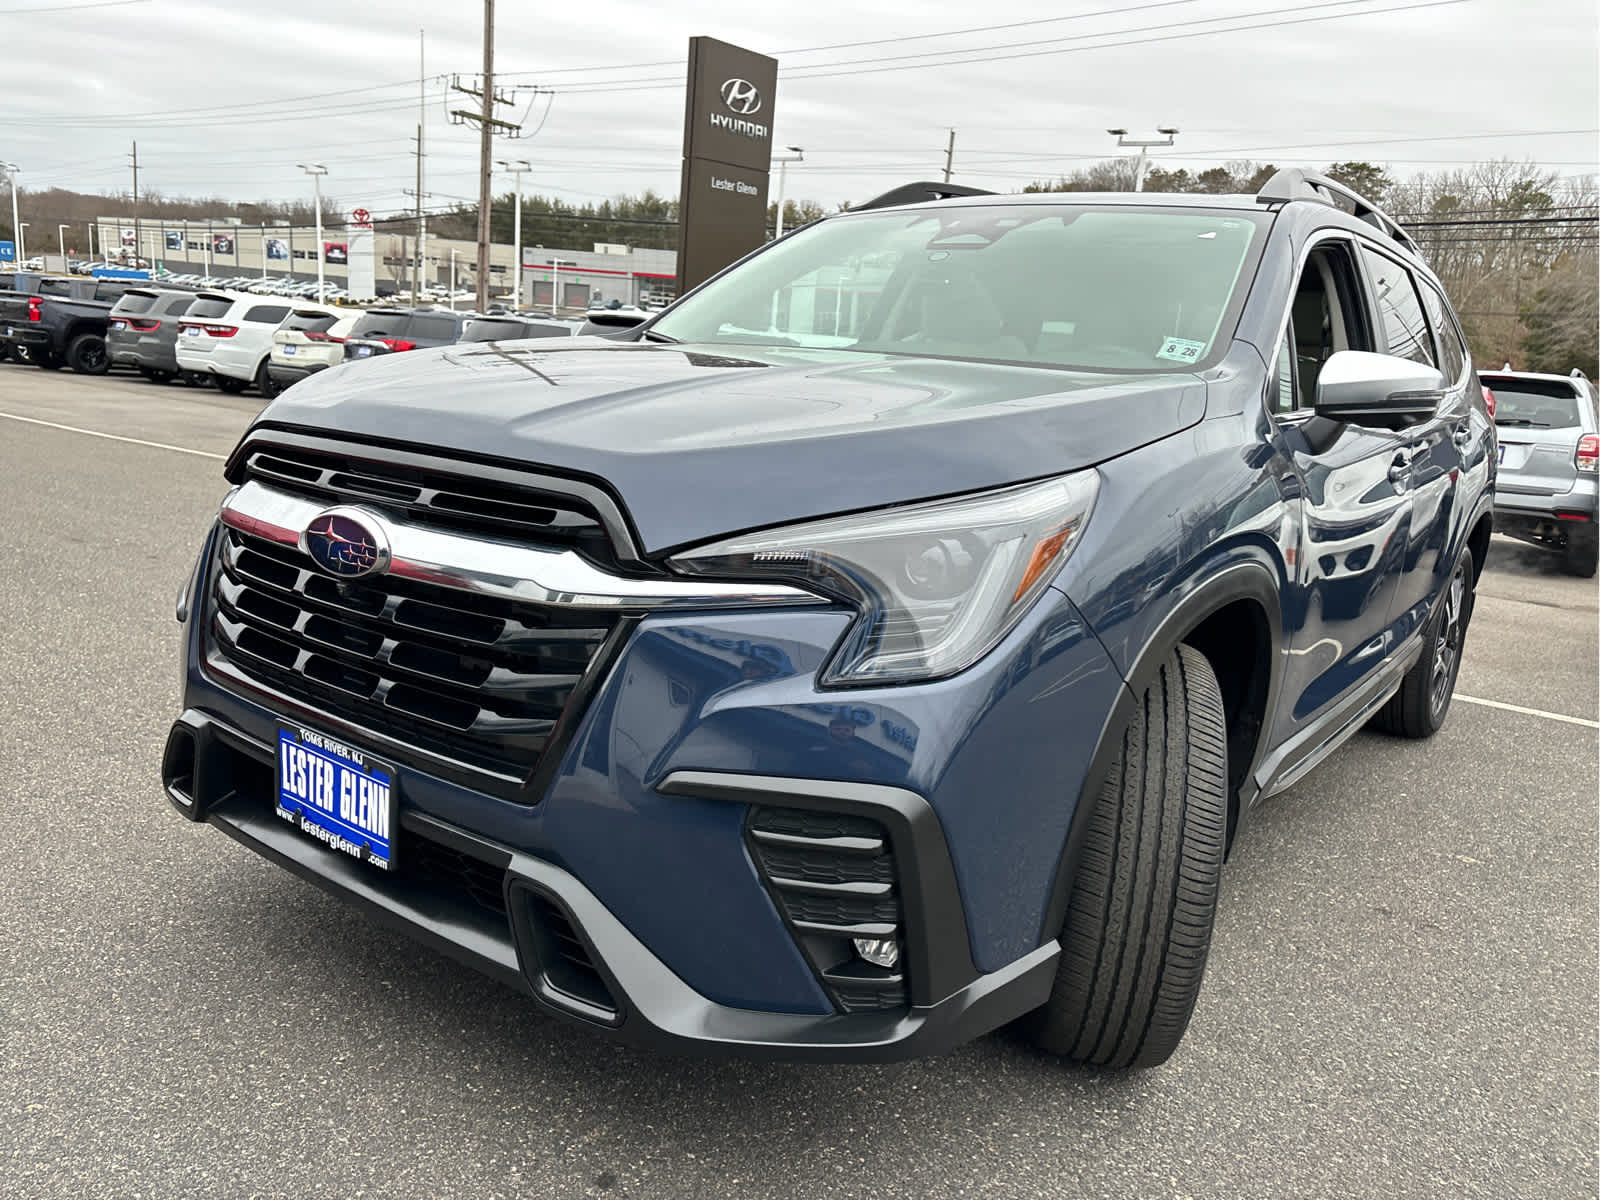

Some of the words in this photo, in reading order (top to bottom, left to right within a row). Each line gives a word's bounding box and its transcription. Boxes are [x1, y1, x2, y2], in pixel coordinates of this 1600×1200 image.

[711, 112, 768, 137] HYUNDAI
[711, 176, 735, 192] Lester
[736, 181, 758, 196] Glenn
[1167, 344, 1177, 353] 8
[300, 728, 323, 748] TOMS
[352, 750, 364, 766] NJ
[281, 742, 334, 813] LESTER
[340, 768, 390, 840] GLENN
[276, 807, 295, 824] www.
[301, 816, 361, 859] lesterglenn
[367, 854, 389, 871] .com
